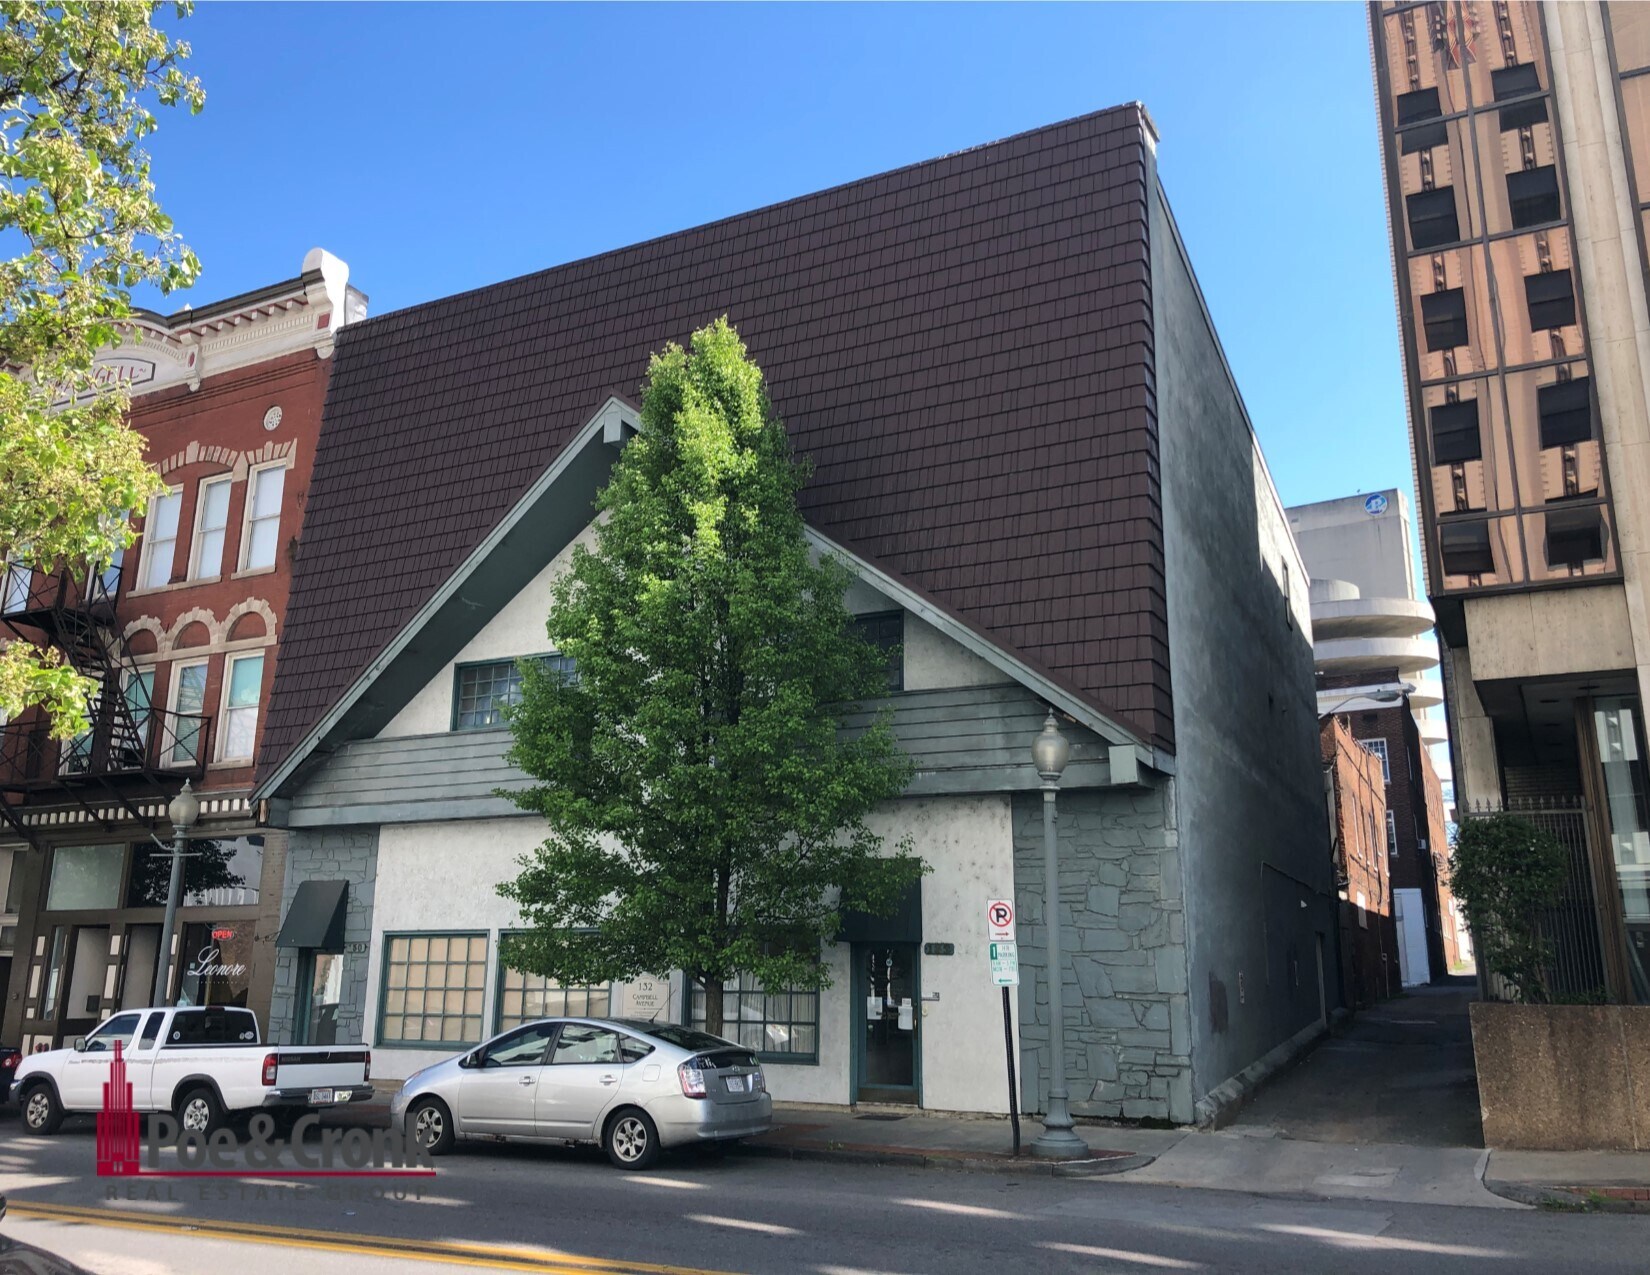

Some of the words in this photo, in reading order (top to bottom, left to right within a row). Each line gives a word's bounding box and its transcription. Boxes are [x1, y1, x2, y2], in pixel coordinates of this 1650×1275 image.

[996, 908, 1007, 922] P
[213, 930, 232, 939] OPEN
[187, 946, 246, 976] Leonore
[639, 983, 653, 991] 132
